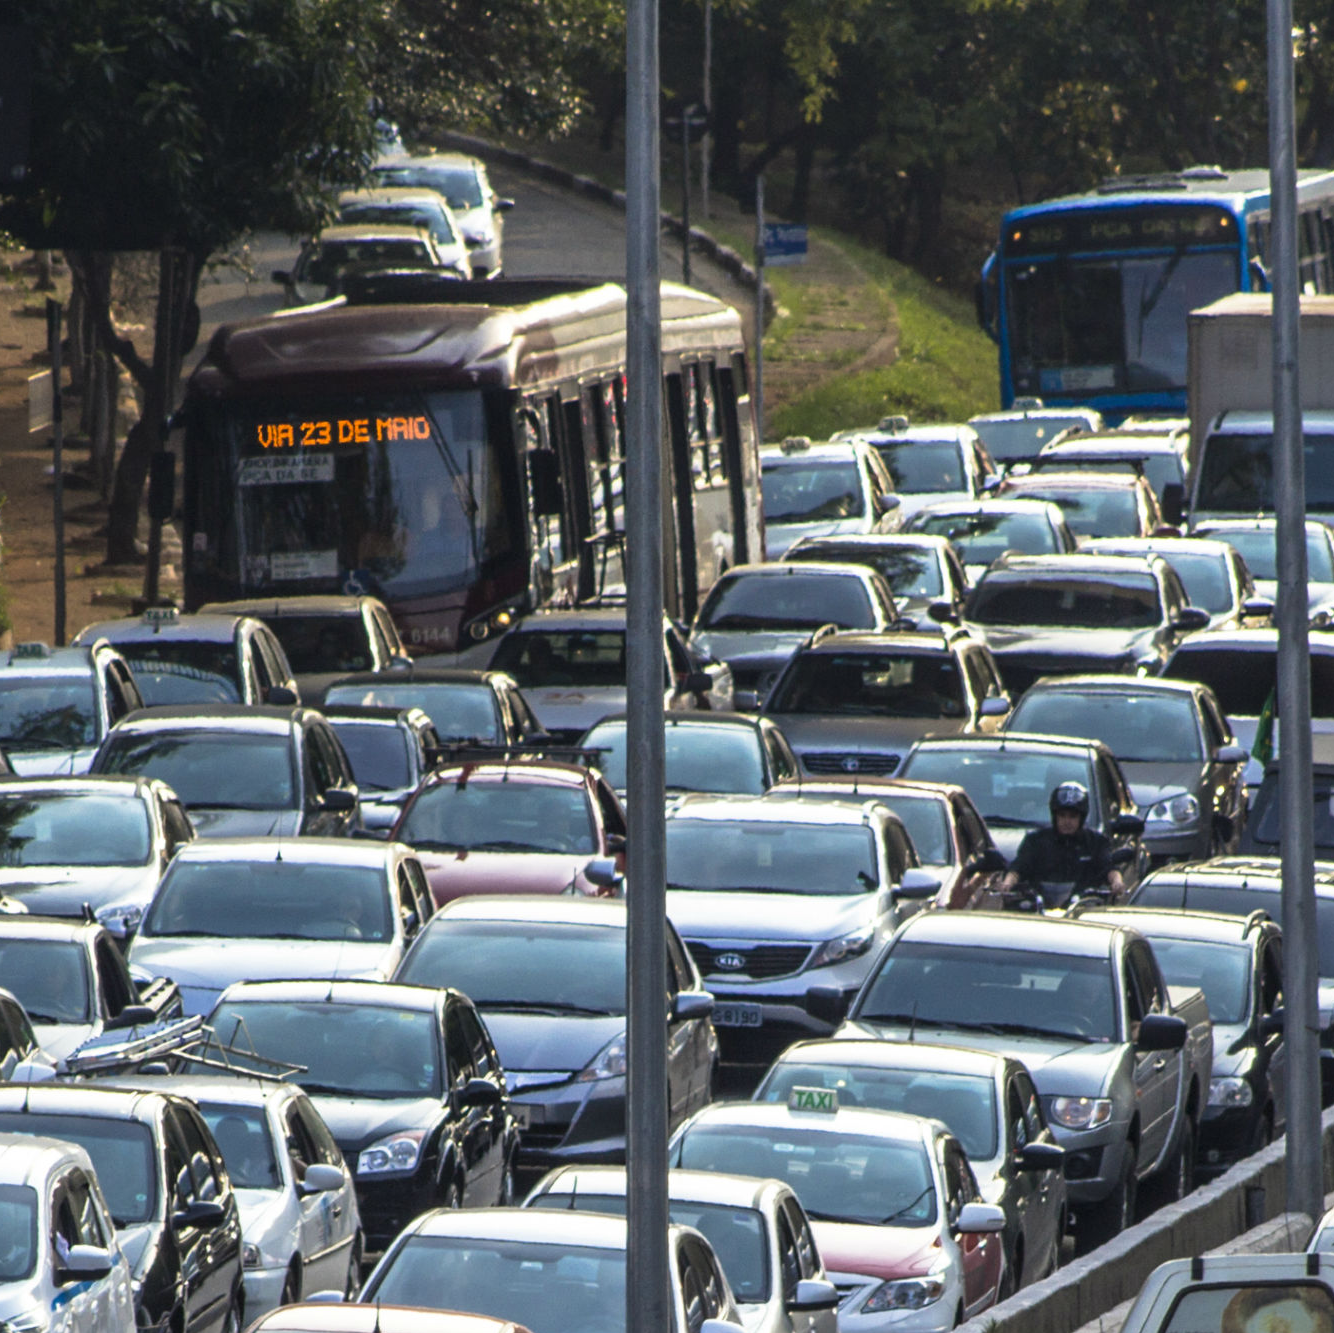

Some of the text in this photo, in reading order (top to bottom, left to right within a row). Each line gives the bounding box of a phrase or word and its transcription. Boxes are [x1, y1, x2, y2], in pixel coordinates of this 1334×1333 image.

[258, 416, 431, 448] VIA 23 DE MAIO
[411, 627, 451, 644] 6144
[719, 956, 741, 967] KIA
[795, 1091, 833, 1110] TAXI
